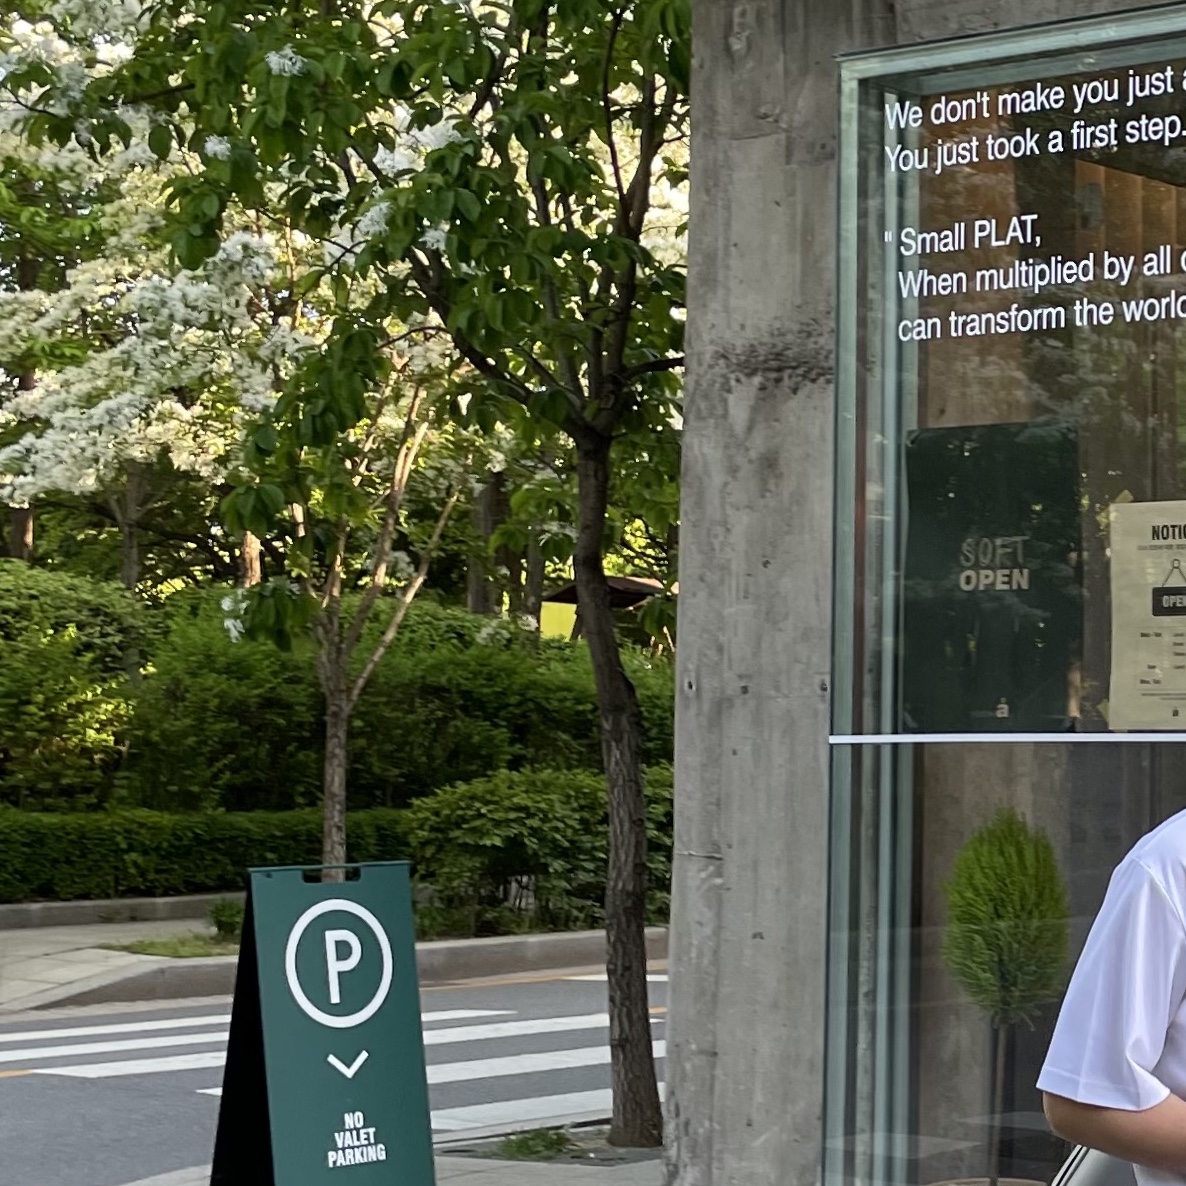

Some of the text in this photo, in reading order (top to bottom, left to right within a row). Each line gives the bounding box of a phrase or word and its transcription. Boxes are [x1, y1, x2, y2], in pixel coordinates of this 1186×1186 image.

[884, 101, 923, 130] We
[930, 92, 990, 124] don't
[998, 82, 1065, 116] make
[1073, 77, 1119, 113] you
[1127, 65, 1174, 107] just
[884, 114, 1186, 175] You just took a first step.
[974, 214, 1041, 249] PLAT,
[898, 269, 967, 298] When
[976, 252, 1094, 294] multiplied
[1104, 251, 1135, 286] by
[1143, 244, 1171, 276] all
[898, 318, 941, 342] can
[948, 303, 1065, 337] transform
[1074, 297, 1114, 327] the
[960, 535, 1031, 567] SOFT
[959, 569, 1030, 591] OPEN
[325, 929, 362, 1004] P
[334, 1127, 376, 1149] VALET
[344, 1111, 364, 1130] NO
[327, 1144, 387, 1168] PARKING
